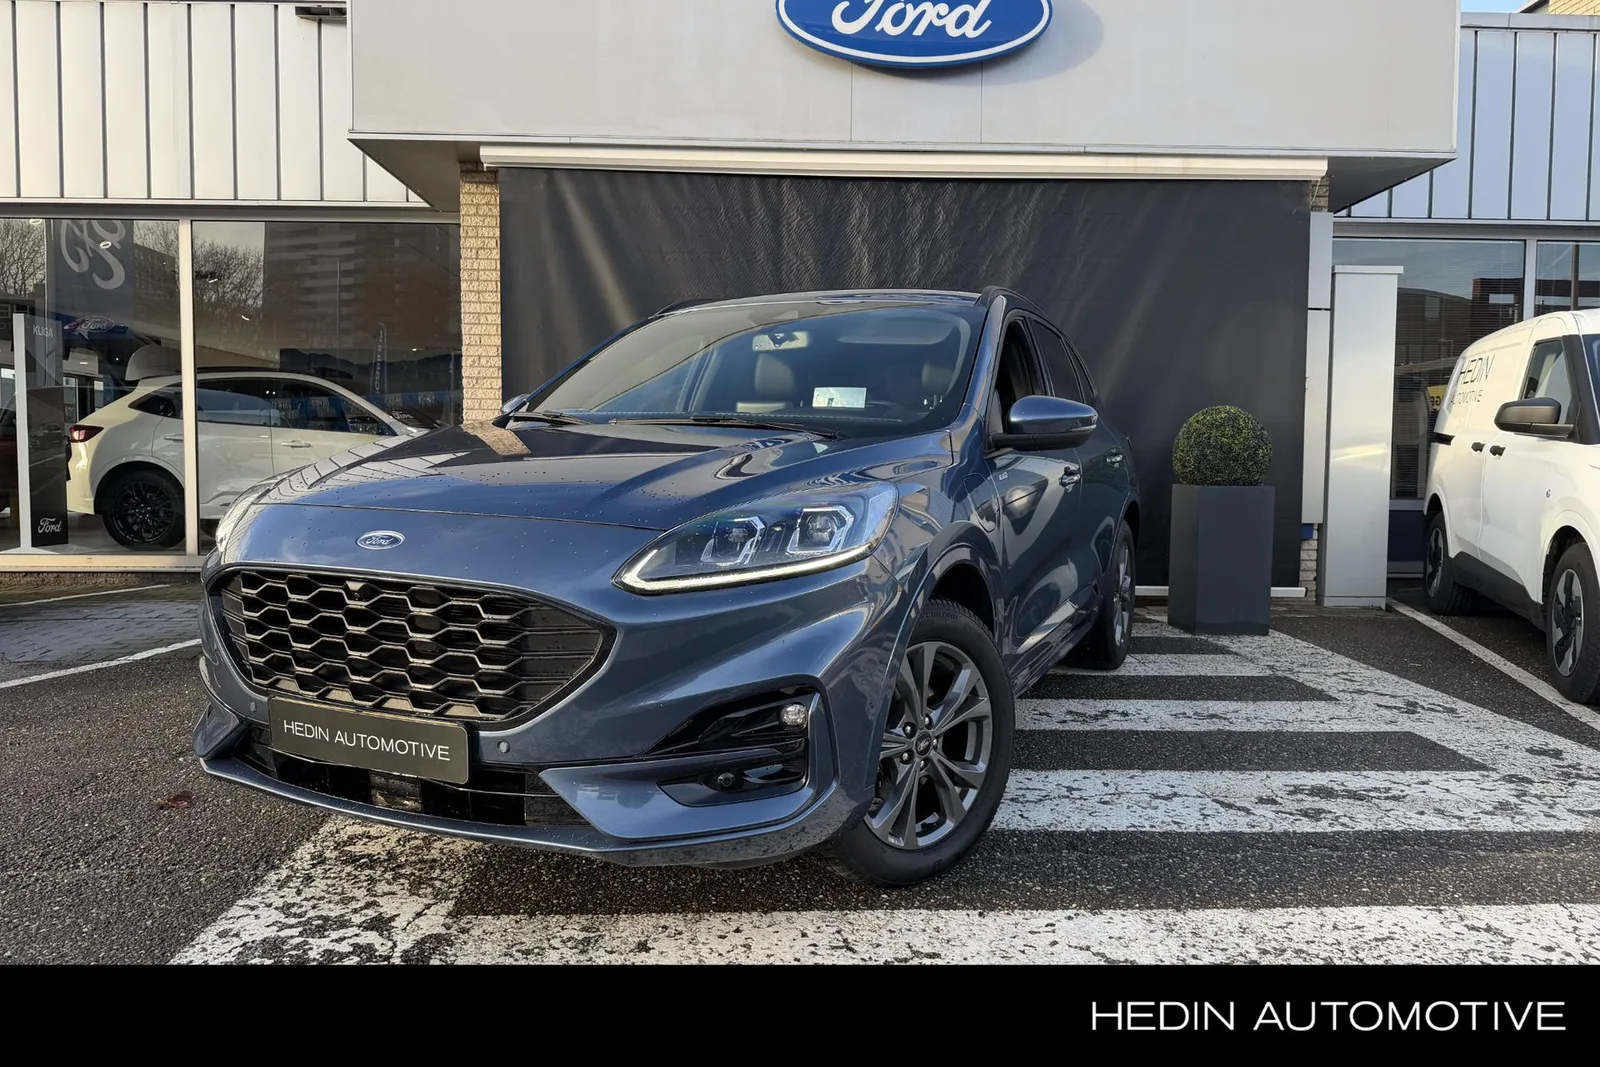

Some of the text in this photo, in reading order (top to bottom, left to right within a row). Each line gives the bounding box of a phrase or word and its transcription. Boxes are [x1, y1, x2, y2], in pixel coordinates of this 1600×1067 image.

[33, 325, 54, 338] KUGA
[1457, 354, 1496, 385] HEDIN
[37, 517, 62, 534] Ford
[365, 535, 394, 546] Ford
[283, 719, 451, 761] HEDIN AUTOMOTIVE
